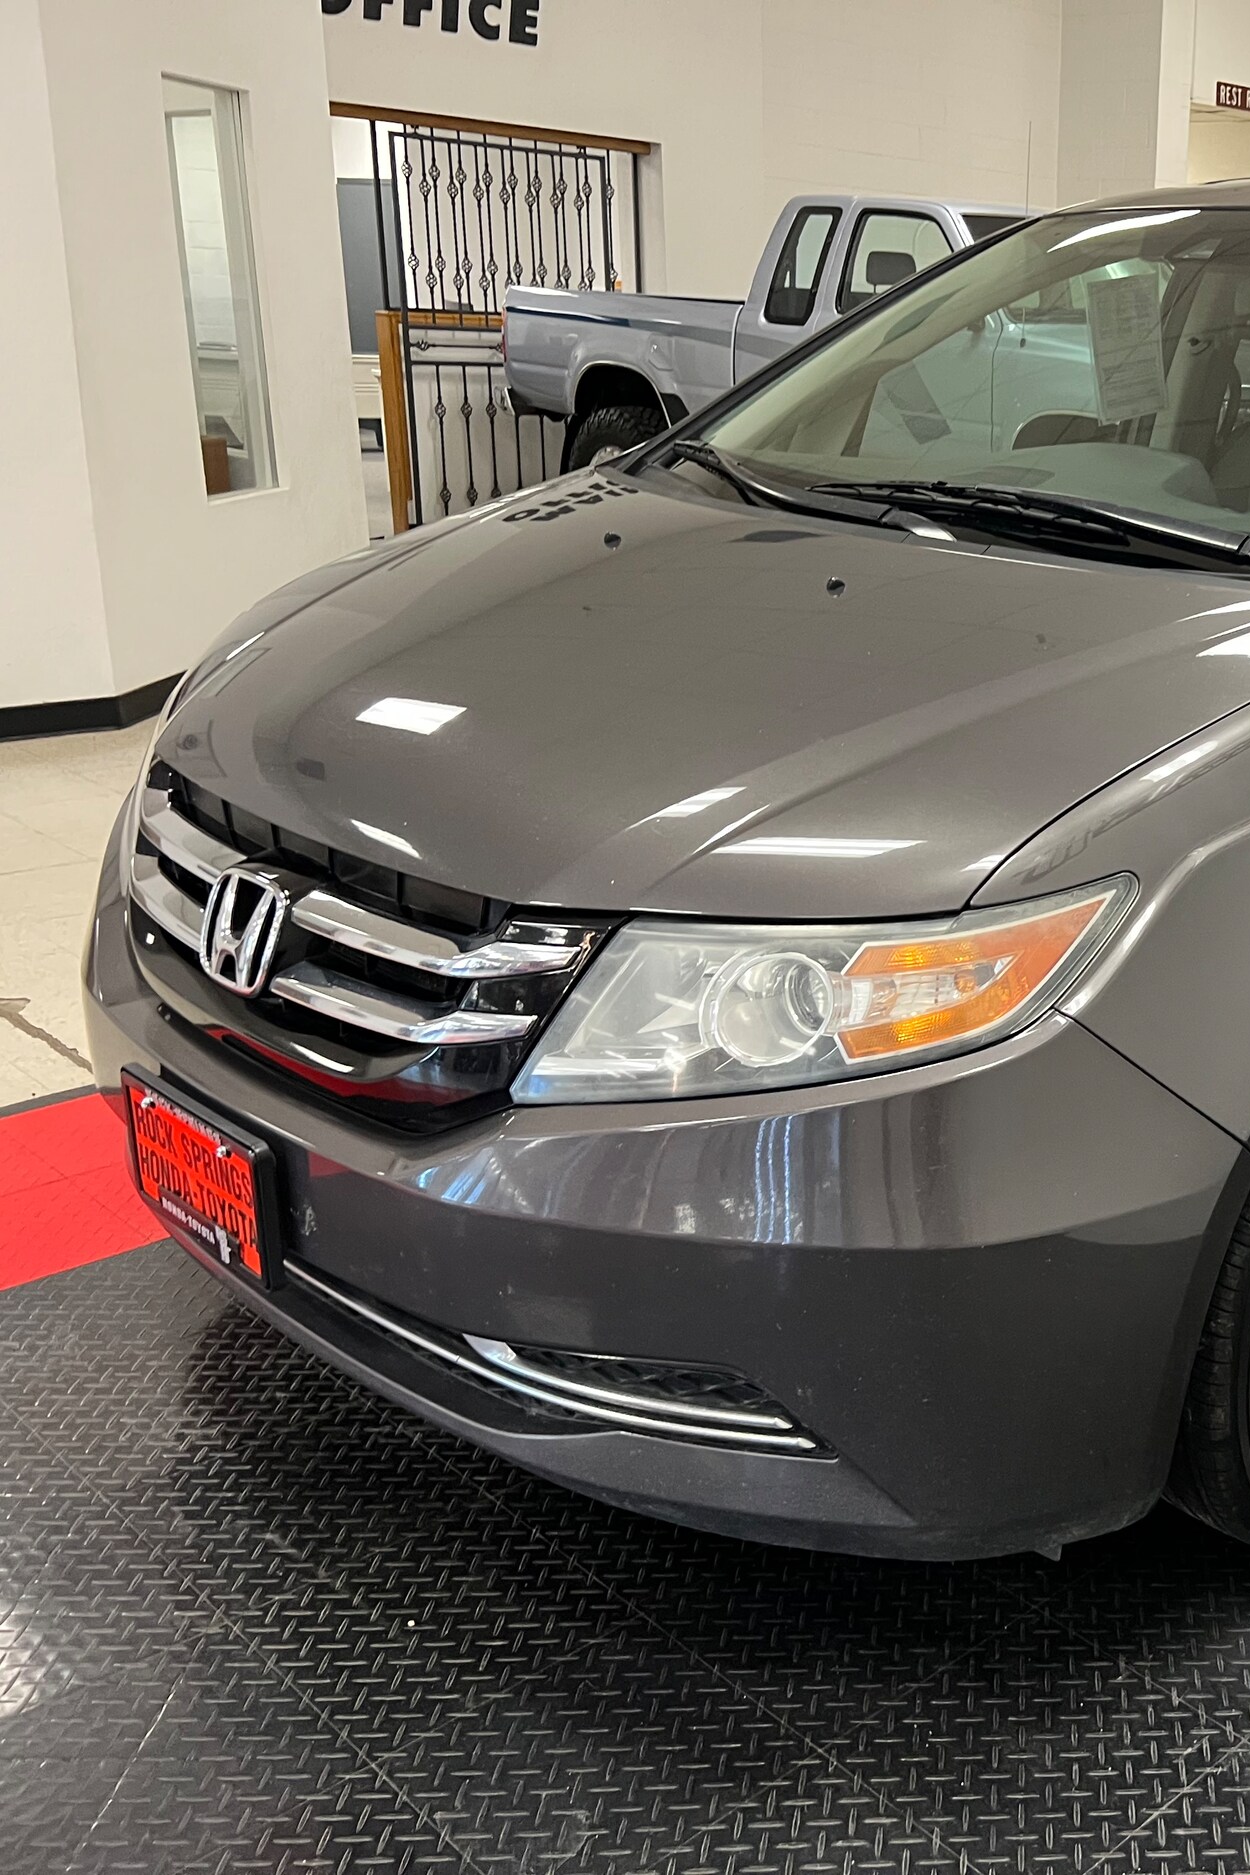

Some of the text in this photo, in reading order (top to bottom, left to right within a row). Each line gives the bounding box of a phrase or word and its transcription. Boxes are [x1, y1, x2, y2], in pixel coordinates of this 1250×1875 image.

[1220, 84, 1243, 107] REST
[135, 1103, 179, 1160] ROCK
[180, 1131, 254, 1209] SPRINGS
